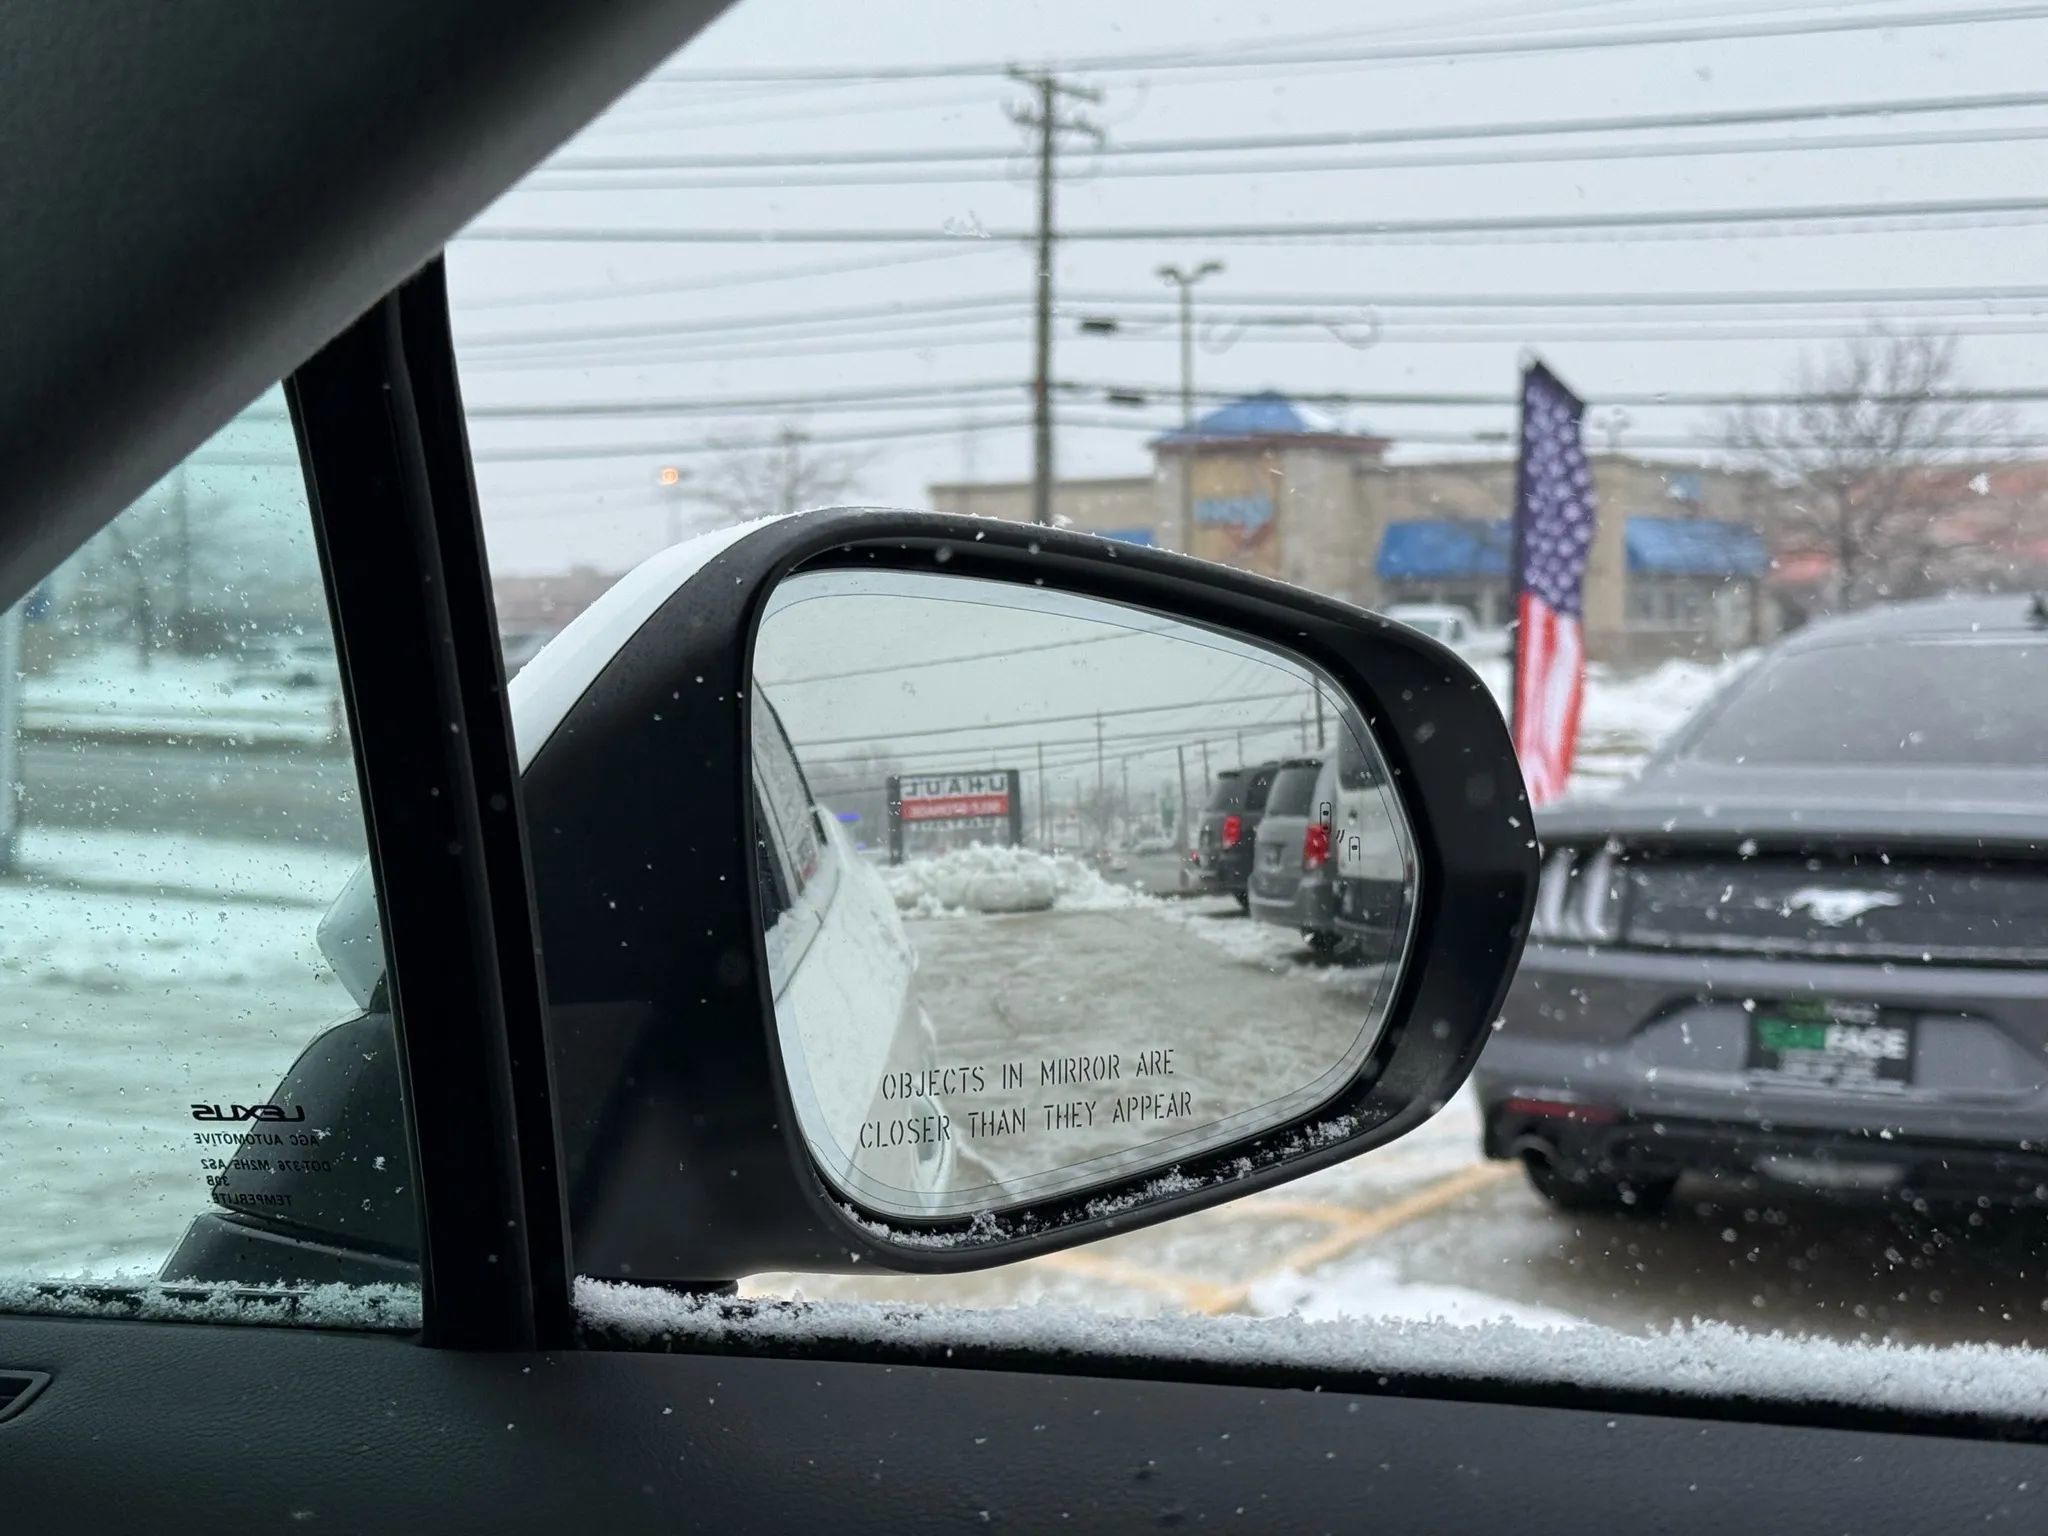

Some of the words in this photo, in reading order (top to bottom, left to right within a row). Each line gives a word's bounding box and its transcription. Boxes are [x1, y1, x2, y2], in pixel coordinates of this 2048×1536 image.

[882, 1066, 985, 1100] OBJECTS
[1002, 1063, 1023, 1090] IN
[1041, 1054, 1121, 1087] MIRROR
[1136, 1049, 1175, 1078] ARE
[859, 1115, 951, 1149] CLOSER
[968, 1107, 1026, 1139] THAN
[1043, 1100, 1096, 1131] THEY
[1112, 1091, 1193, 1124] APPEAR
